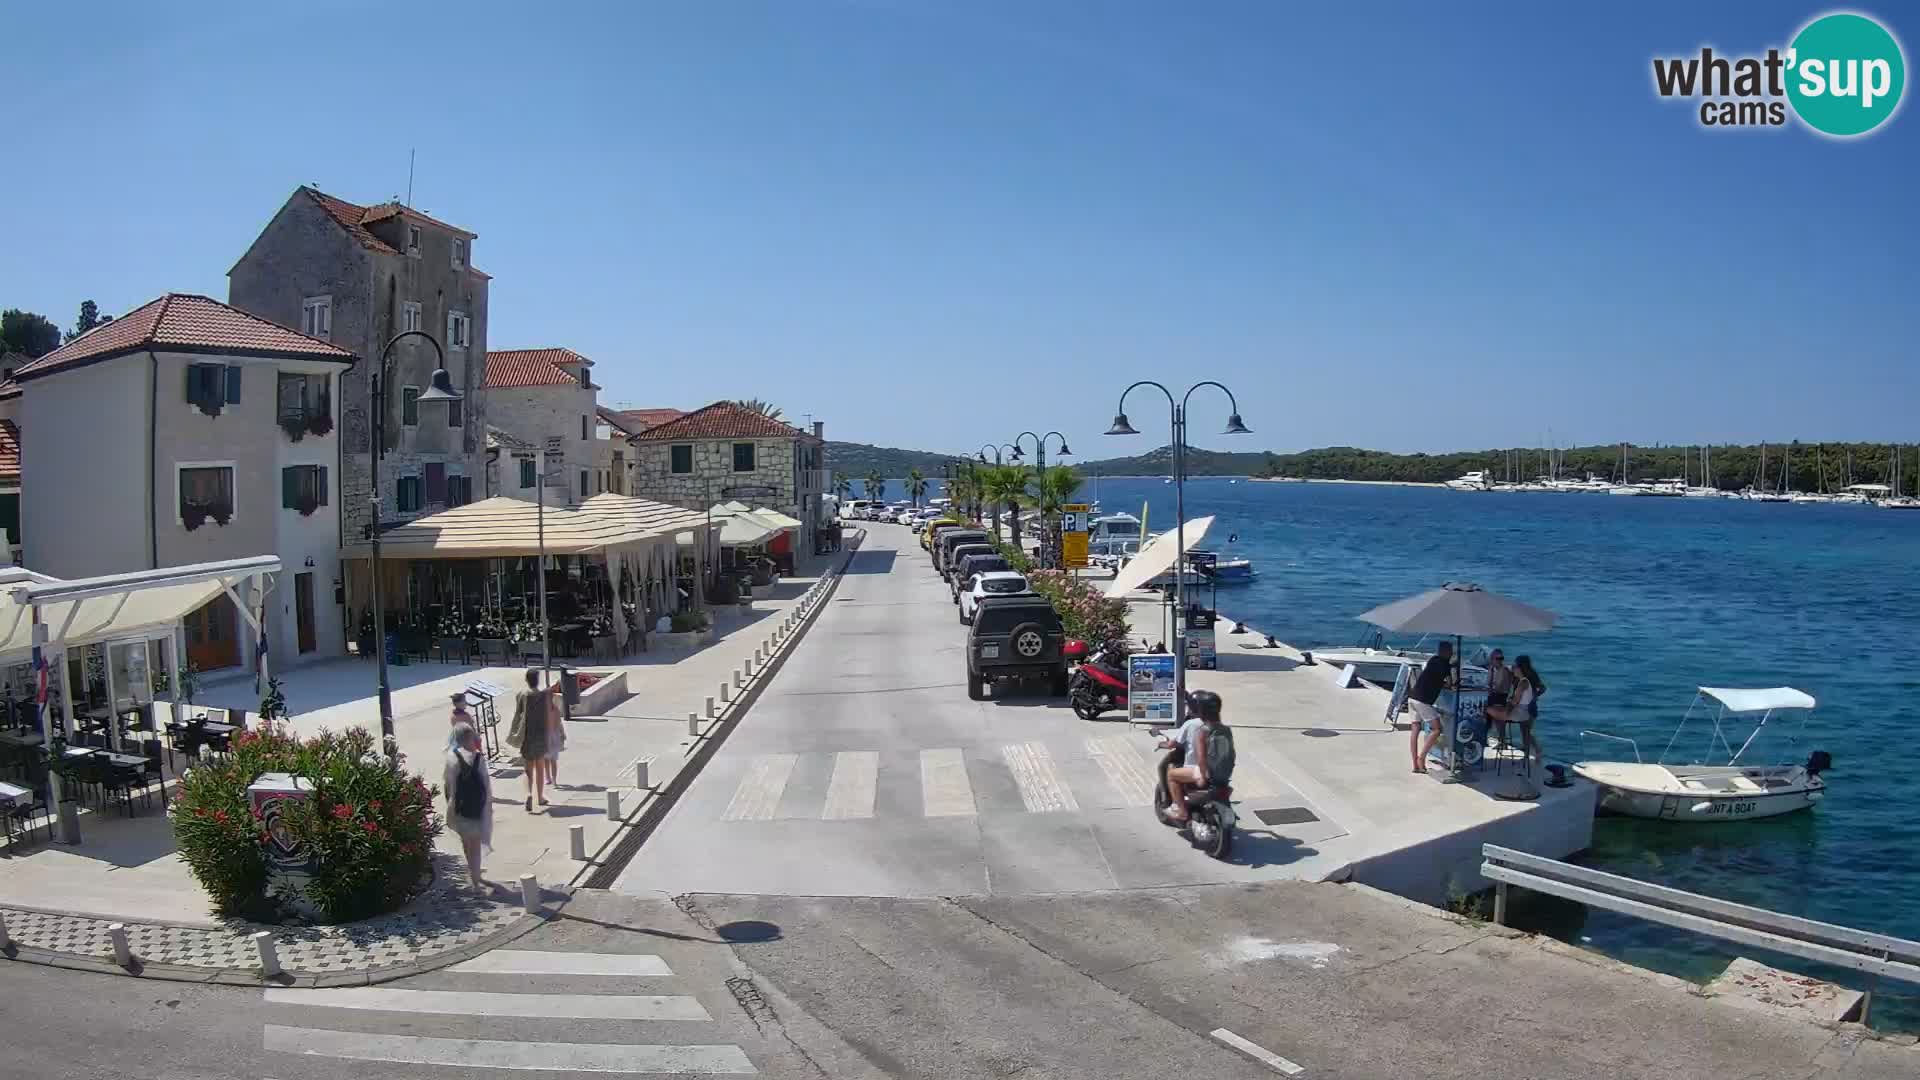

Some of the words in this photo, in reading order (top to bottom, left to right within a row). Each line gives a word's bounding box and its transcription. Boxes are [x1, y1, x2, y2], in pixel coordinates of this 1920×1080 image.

[1064, 514, 1075, 530] P
[1726, 803, 1733, 814] A
[1735, 802, 1757, 814] BOAT
